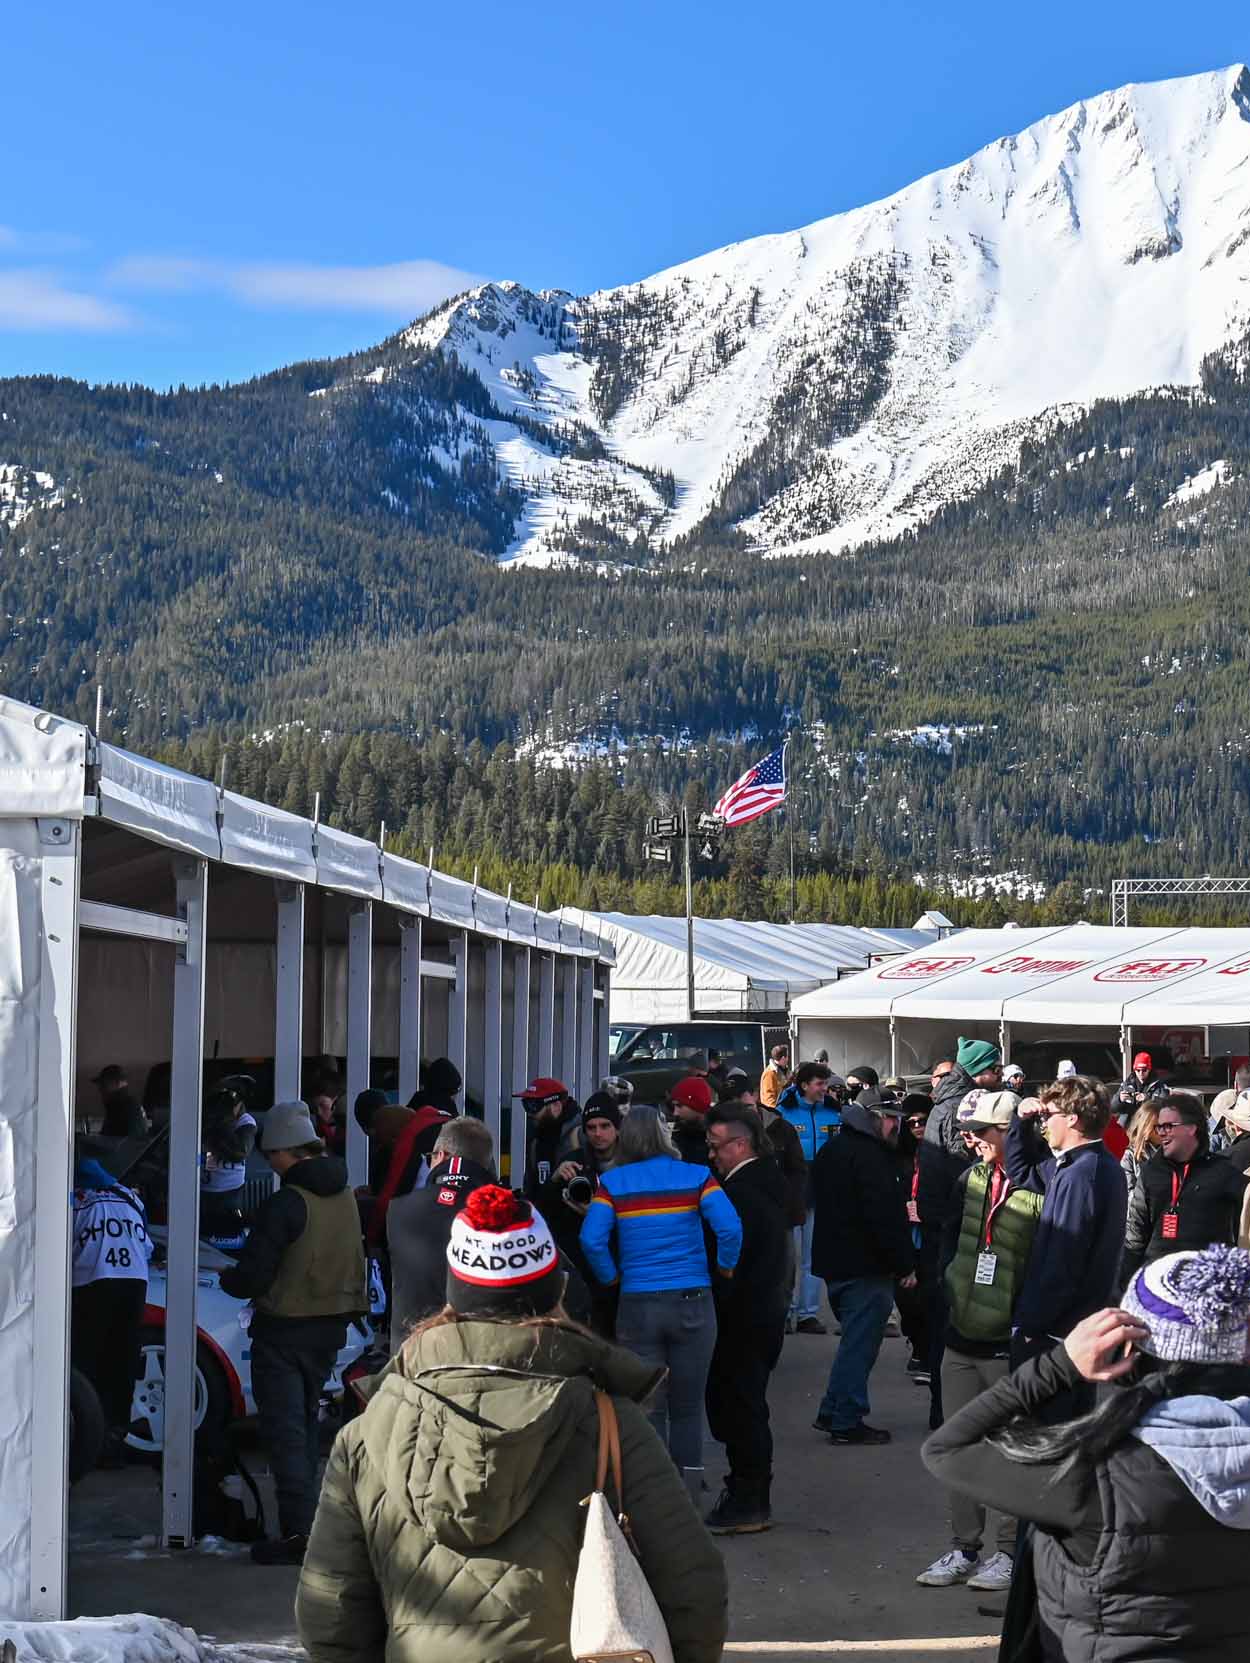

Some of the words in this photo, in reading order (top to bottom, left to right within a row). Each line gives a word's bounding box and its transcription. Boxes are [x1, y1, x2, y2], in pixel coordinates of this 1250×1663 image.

[442, 1174, 469, 1182] SONY
[79, 1218, 146, 1248] PHOTO
[465, 1234, 486, 1250] MT.
[492, 1234, 536, 1252] HOOD
[105, 1247, 131, 1268] 48
[452, 1240, 552, 1271] MEADOWS
